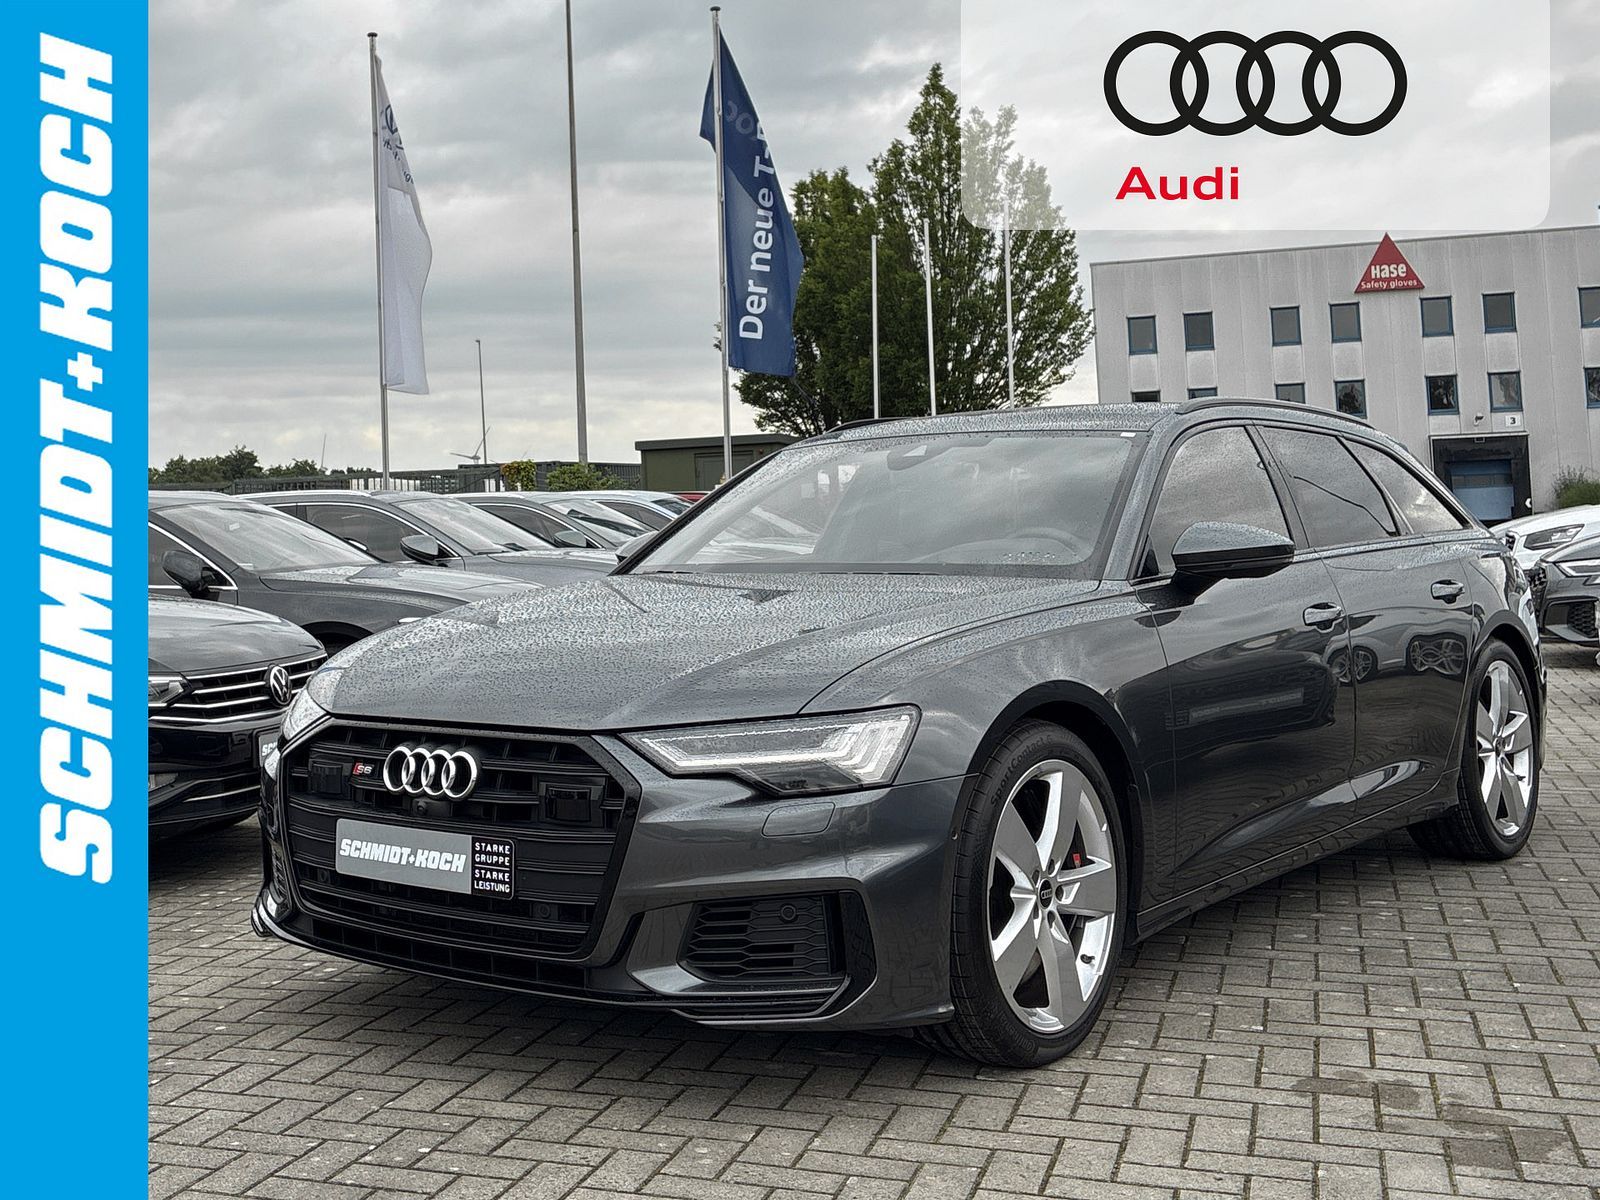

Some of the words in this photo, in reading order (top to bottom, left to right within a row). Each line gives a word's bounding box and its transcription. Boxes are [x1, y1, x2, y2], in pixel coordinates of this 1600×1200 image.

[750, 187, 774, 273] neue
[1361, 280, 1388, 290] Safety
[1389, 279, 1418, 289] gloves
[739, 279, 768, 340] Der
[1510, 417, 1516, 425] 3
[354, 762, 373, 775] S6
[474, 842, 511, 855] STARKE
[339, 838, 467, 873] SCHMIDT+KOCH
[474, 853, 511, 866] GRUPPE
[474, 869, 511, 882] STARKE
[473, 880, 511, 894] LEISTUNG
